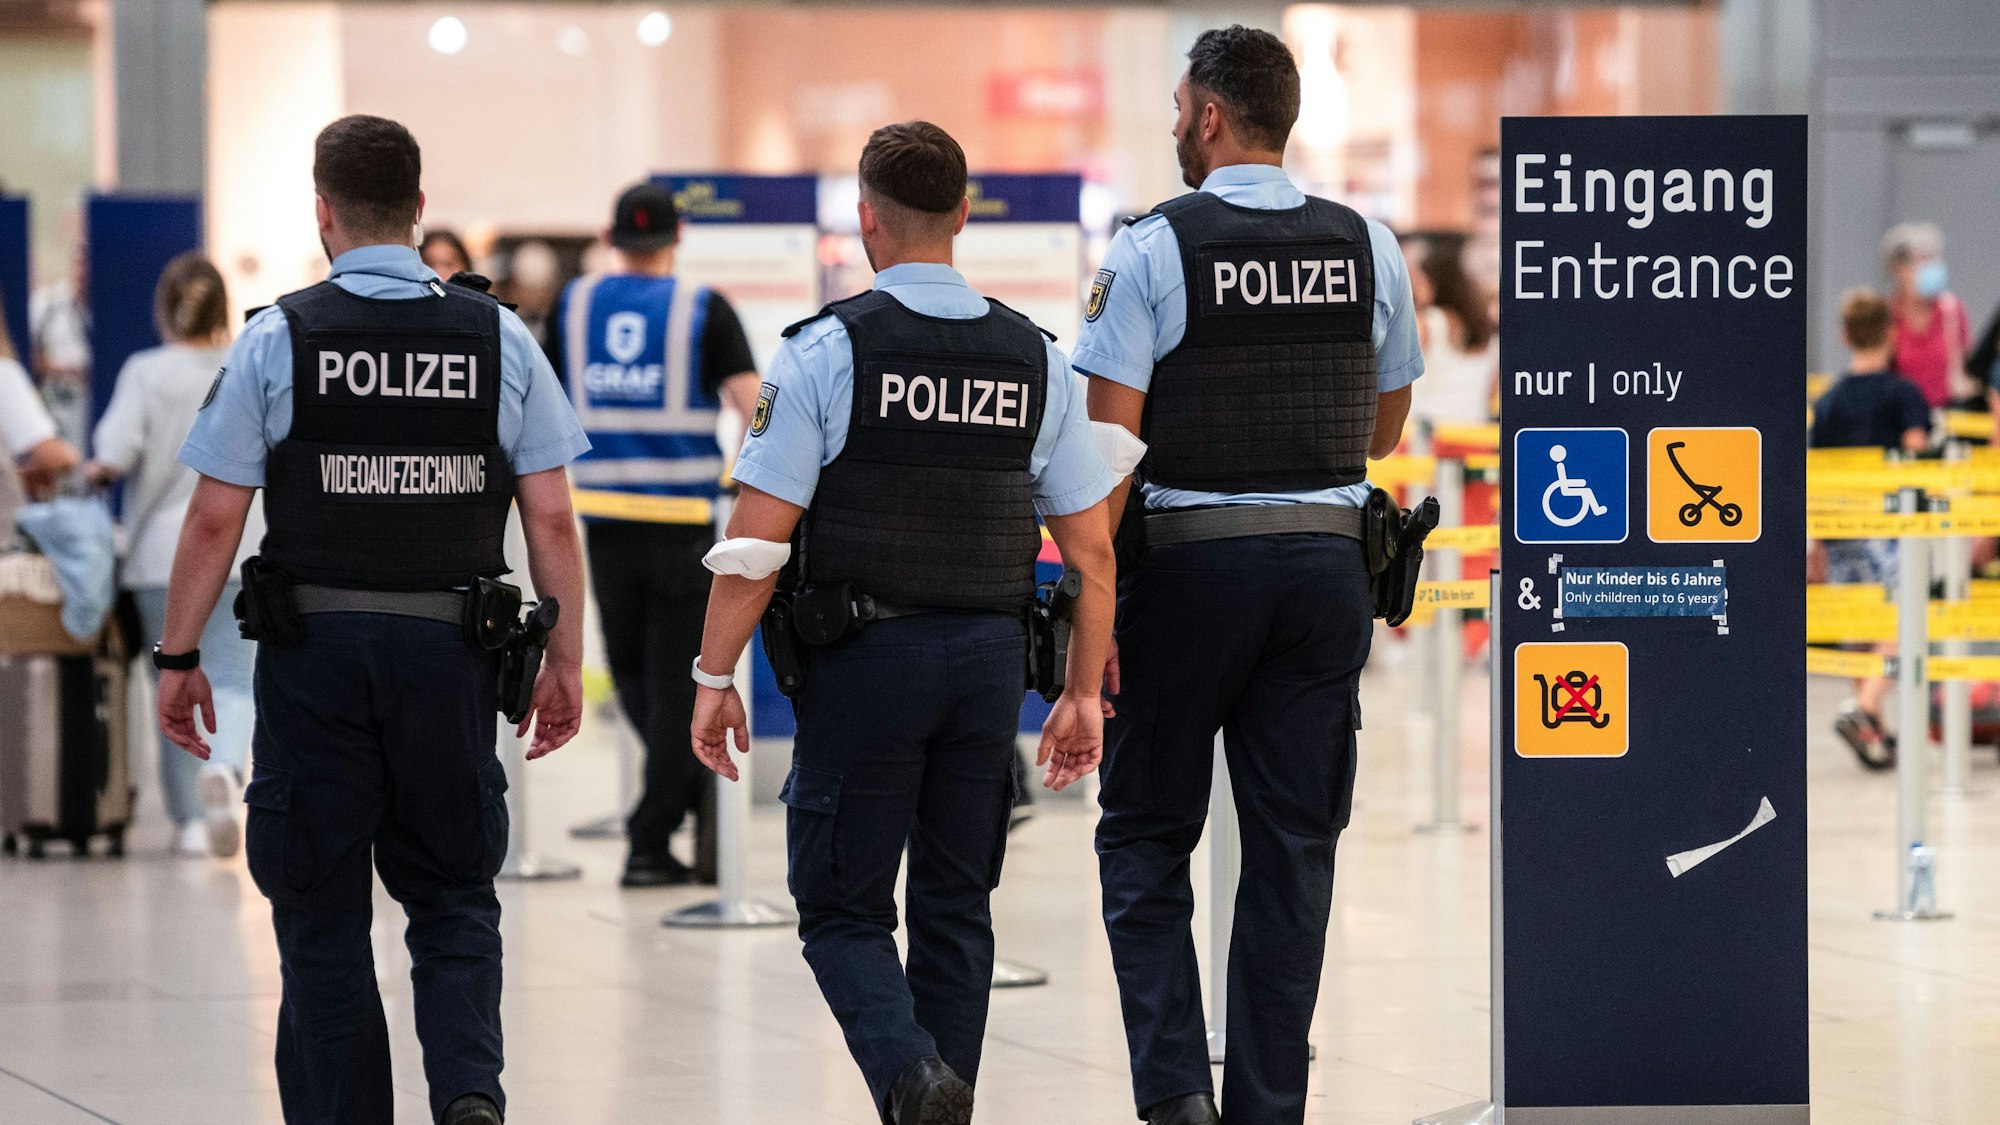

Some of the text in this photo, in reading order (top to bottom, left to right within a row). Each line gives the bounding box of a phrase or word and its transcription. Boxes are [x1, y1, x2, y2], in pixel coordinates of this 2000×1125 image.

[1515, 153, 1774, 230] Eingang
[1213, 259, 1358, 305] POLIZEI
[1515, 240, 1794, 300] Entrance
[318, 350, 477, 399] POLIZEI
[1514, 371, 1573, 396] nur
[1612, 362, 1683, 403] only
[879, 373, 1029, 428] POLIZEI
[320, 454, 485, 495] VIDEOAUFZEICHNUNG
[1517, 576, 1542, 611] &
[1565, 591, 1593, 605] Only
[1594, 591, 1641, 603] children
[1644, 594, 1660, 606] up
[1661, 593, 1675, 604] to
[1677, 592, 1685, 604] 6
[1687, 594, 1719, 606] years
[1566, 571, 1722, 586] Nur Kinder bis 6 Jahre
